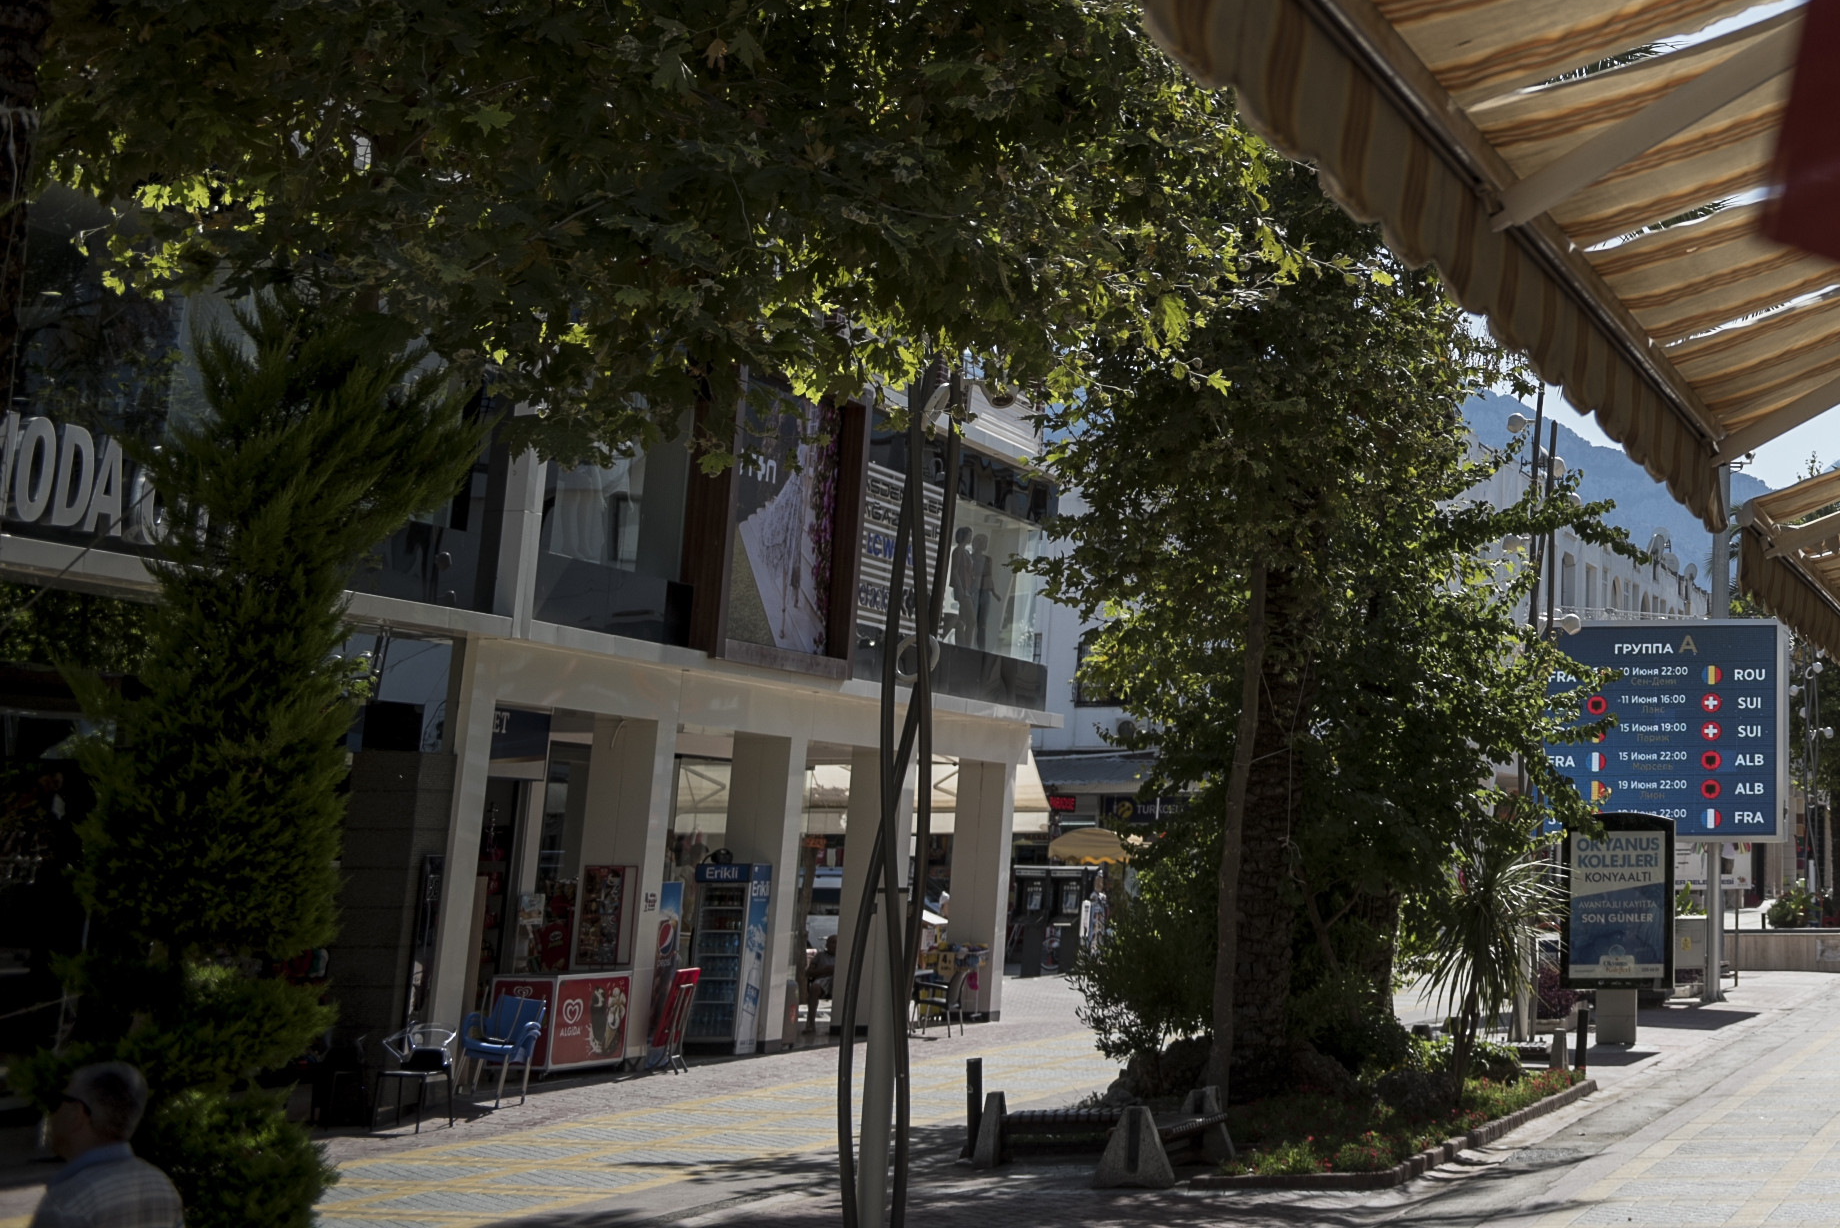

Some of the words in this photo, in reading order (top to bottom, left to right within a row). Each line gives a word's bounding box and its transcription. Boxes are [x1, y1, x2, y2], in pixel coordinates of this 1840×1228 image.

[1614, 643, 1674, 655] ГРУППА
[1620, 667, 1631, 677] 0
[1632, 667, 1659, 677] Июня
[1660, 666, 1689, 676] 22:00
[1733, 668, 1767, 681] ROU
[1621, 695, 1629, 704] 11
[1631, 696, 1658, 705] Июня
[1659, 695, 1687, 704] 16:00
[1737, 696, 1762, 709] SUI
[1620, 723, 1630, 732] 15
[1631, 724, 1658, 733] Июня
[1660, 723, 1687, 732] 19:00
[1737, 725, 1762, 738] SUI
[1619, 752, 1628, 761] 15
[1630, 752, 1658, 762] Июня
[1659, 751, 1688, 761] 22:00
[1735, 753, 1765, 767] ALB
[1618, 780, 1628, 790] 19
[1630, 781, 1658, 790] Июня
[1659, 780, 1688, 790] 22:00
[1735, 782, 1765, 795] ALB
[1659, 809, 1688, 819] 22:00
[1734, 811, 1765, 824] FRA
[1576, 837, 1660, 852] OKYANUS
[1577, 852, 1659, 868] KOLEJLERİ
[706, 867, 738, 879] Erikli
[1585, 871, 1652, 883] KONYAALTI
[1582, 913, 1605, 924] SON
[1608, 911, 1654, 924] GÜNLER
